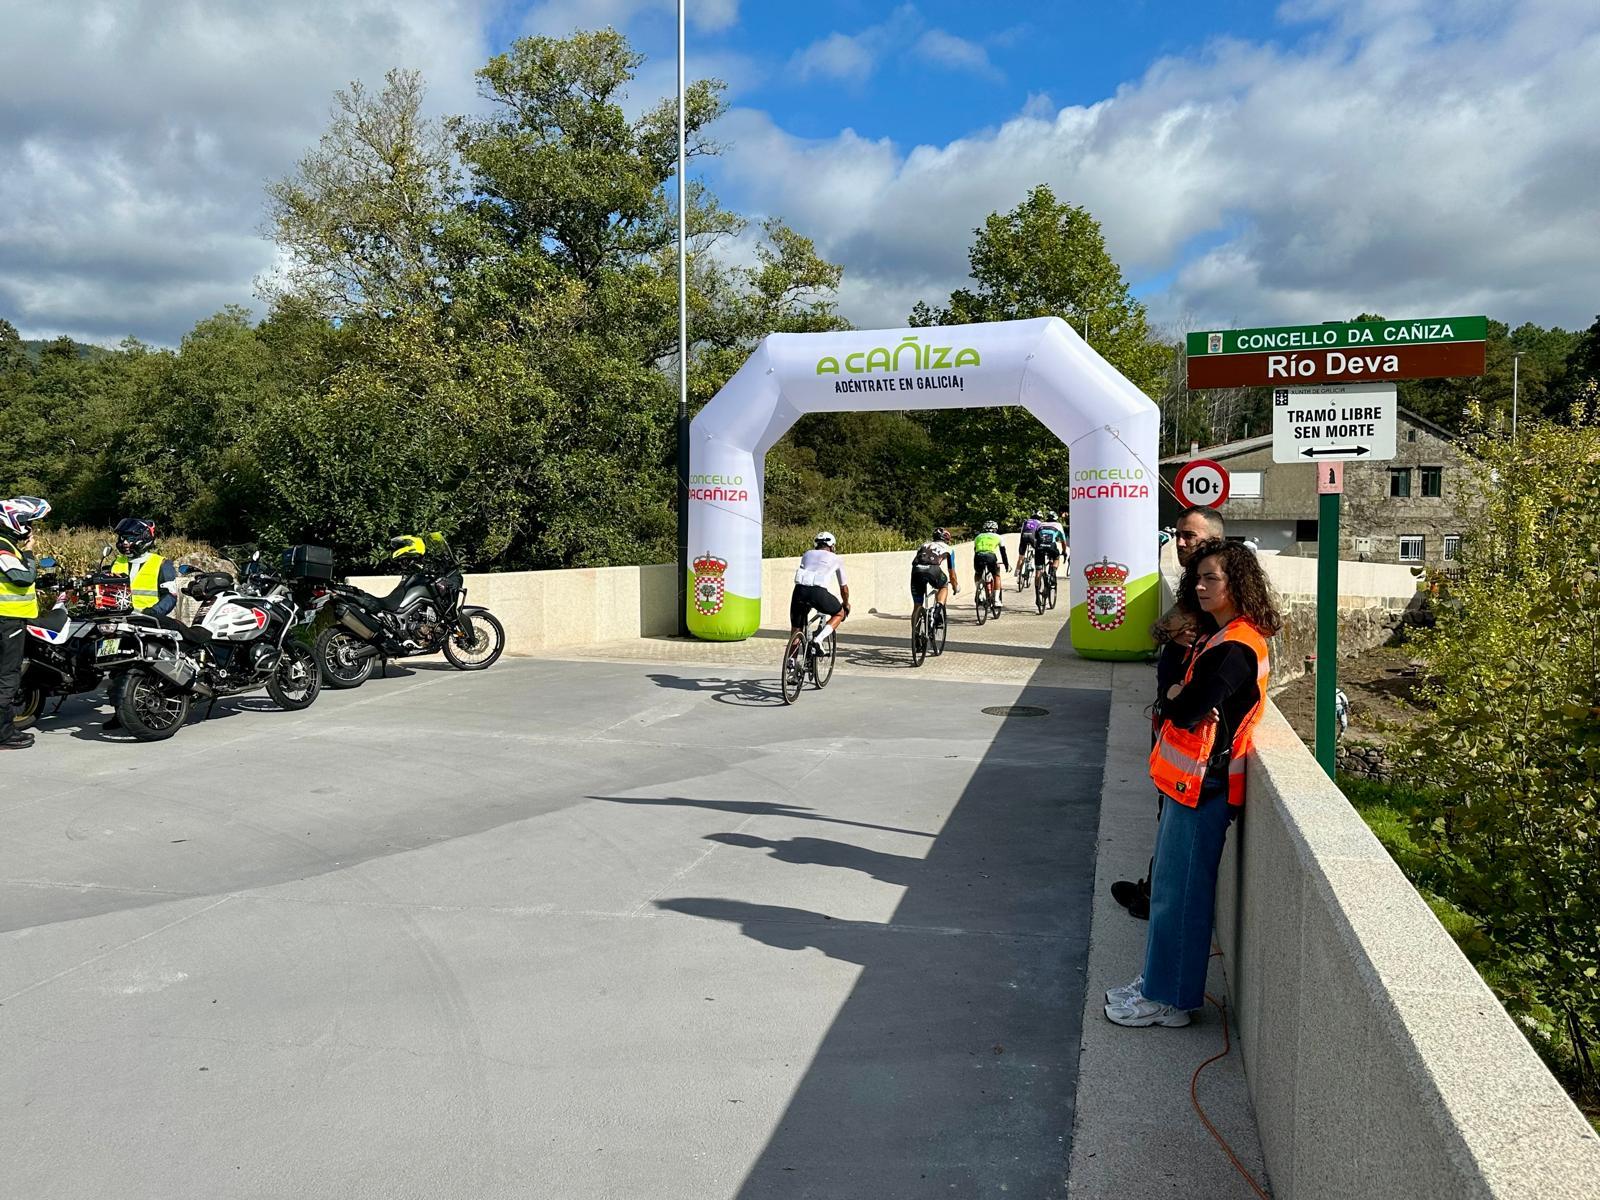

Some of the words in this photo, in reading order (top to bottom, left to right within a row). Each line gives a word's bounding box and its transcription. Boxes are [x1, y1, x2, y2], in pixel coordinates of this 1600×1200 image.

[1237, 330, 1337, 349] CONCELLO
[1348, 328, 1374, 343] DA
[1383, 322, 1454, 341] CAÑIZA
[816, 356, 840, 375] A
[845, 336, 981, 373] CAÑIZA
[1268, 354, 1316, 378] Río
[1326, 352, 1399, 375] Deva
[835, 378, 896, 393] ADÉNTRATE
[900, 377, 913, 390] EN
[917, 375, 964, 391] GALICIA!
[1287, 409, 1336, 422] TRAMO
[1342, 407, 1382, 420] LIBRE
[1294, 426, 1320, 439] SEN
[1325, 424, 1375, 437] MORTE
[1075, 468, 1143, 481] CONCELLO
